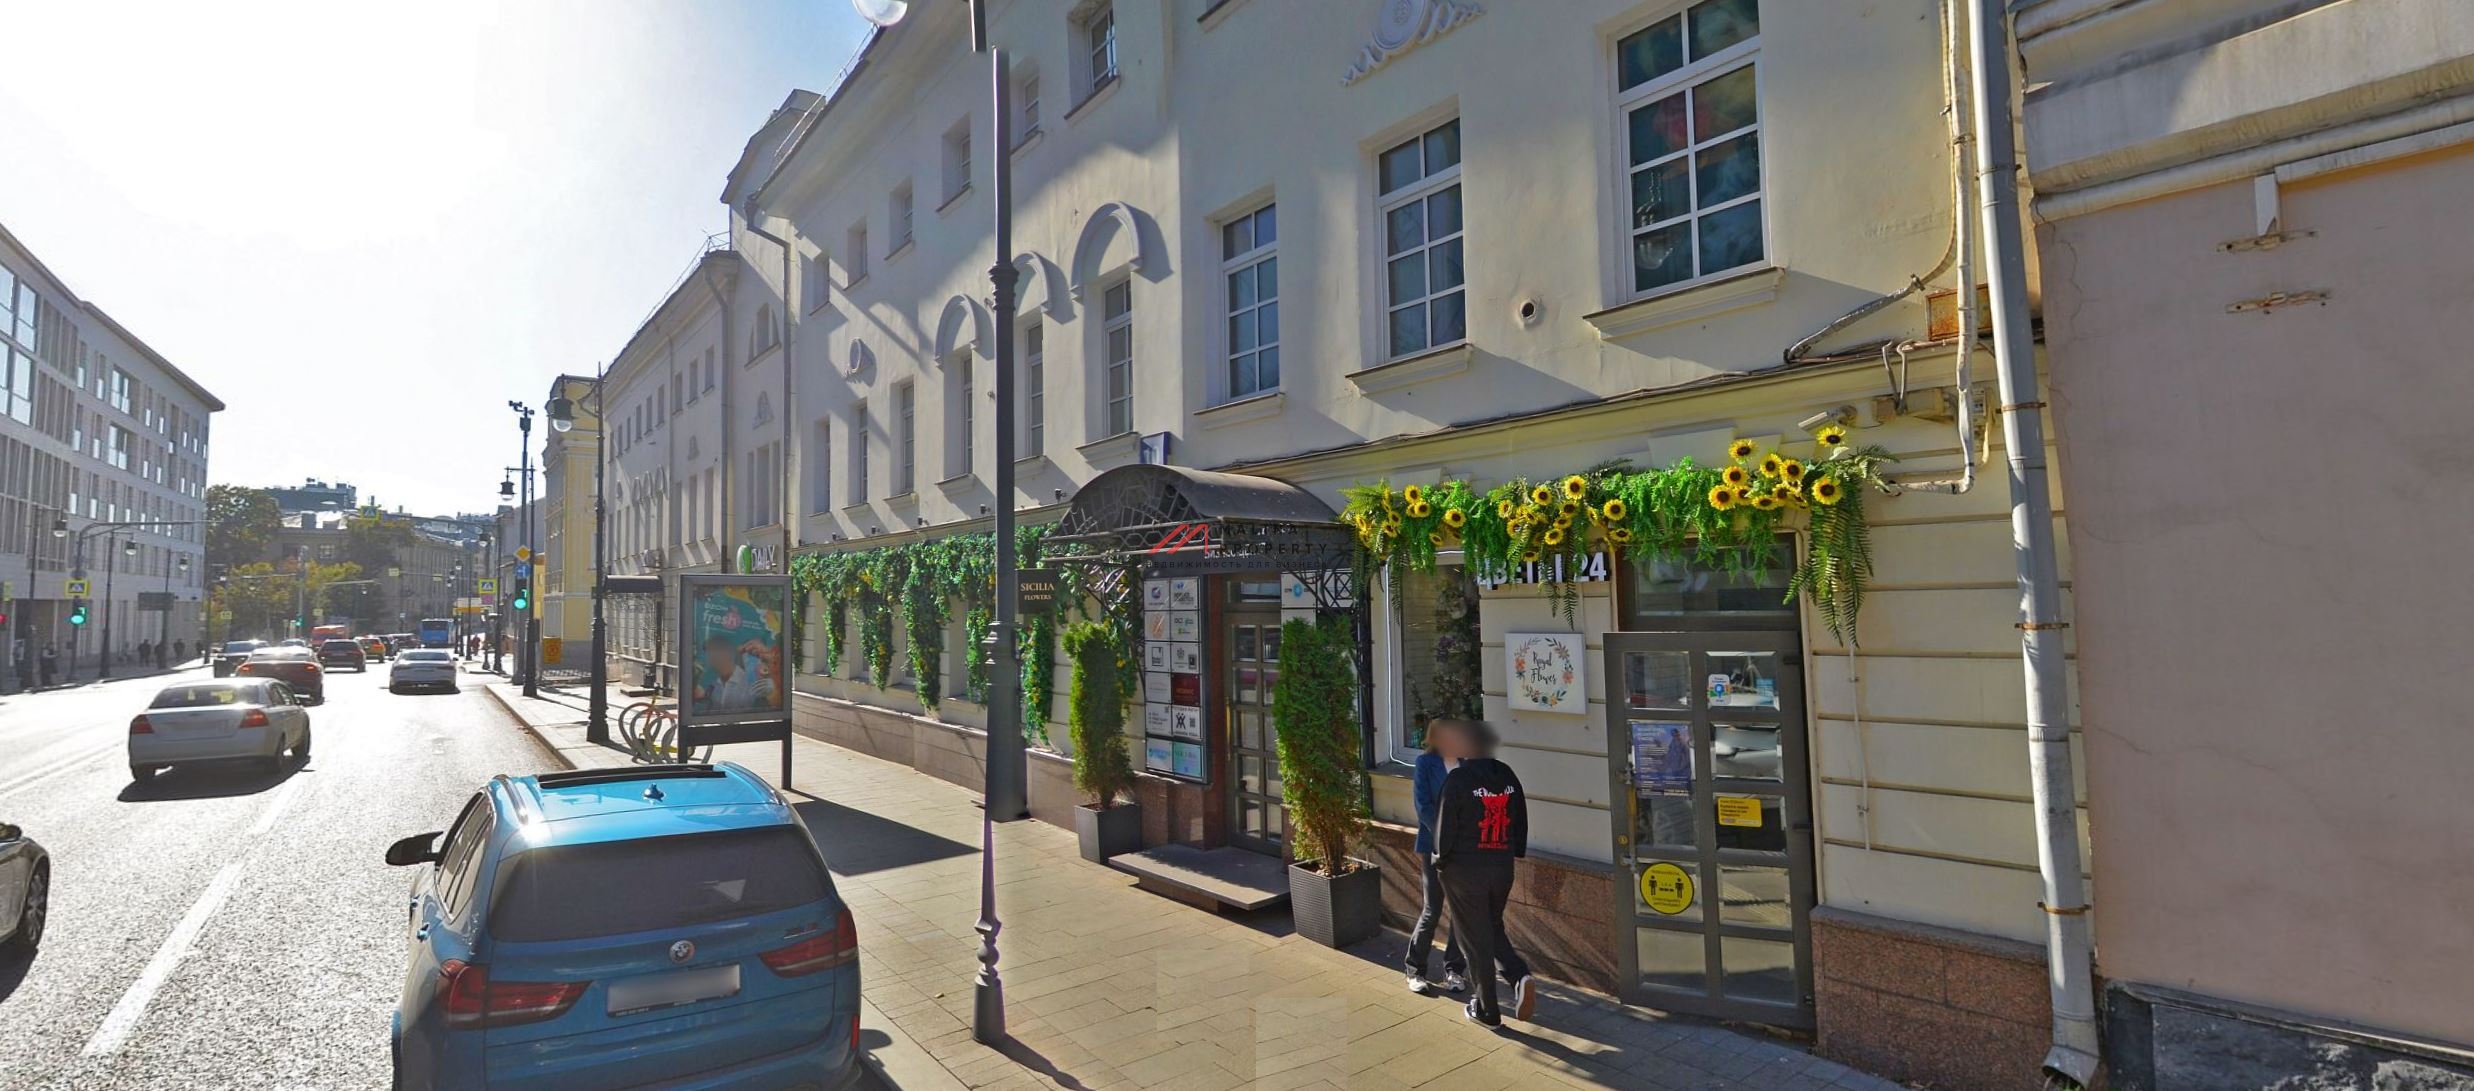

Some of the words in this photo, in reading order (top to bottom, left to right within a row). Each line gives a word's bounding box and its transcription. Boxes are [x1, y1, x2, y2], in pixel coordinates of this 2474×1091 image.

[1573, 552, 1607, 583] 24
[1020, 582, 1055, 592] SICILIA
[703, 610, 737, 627] fresh
